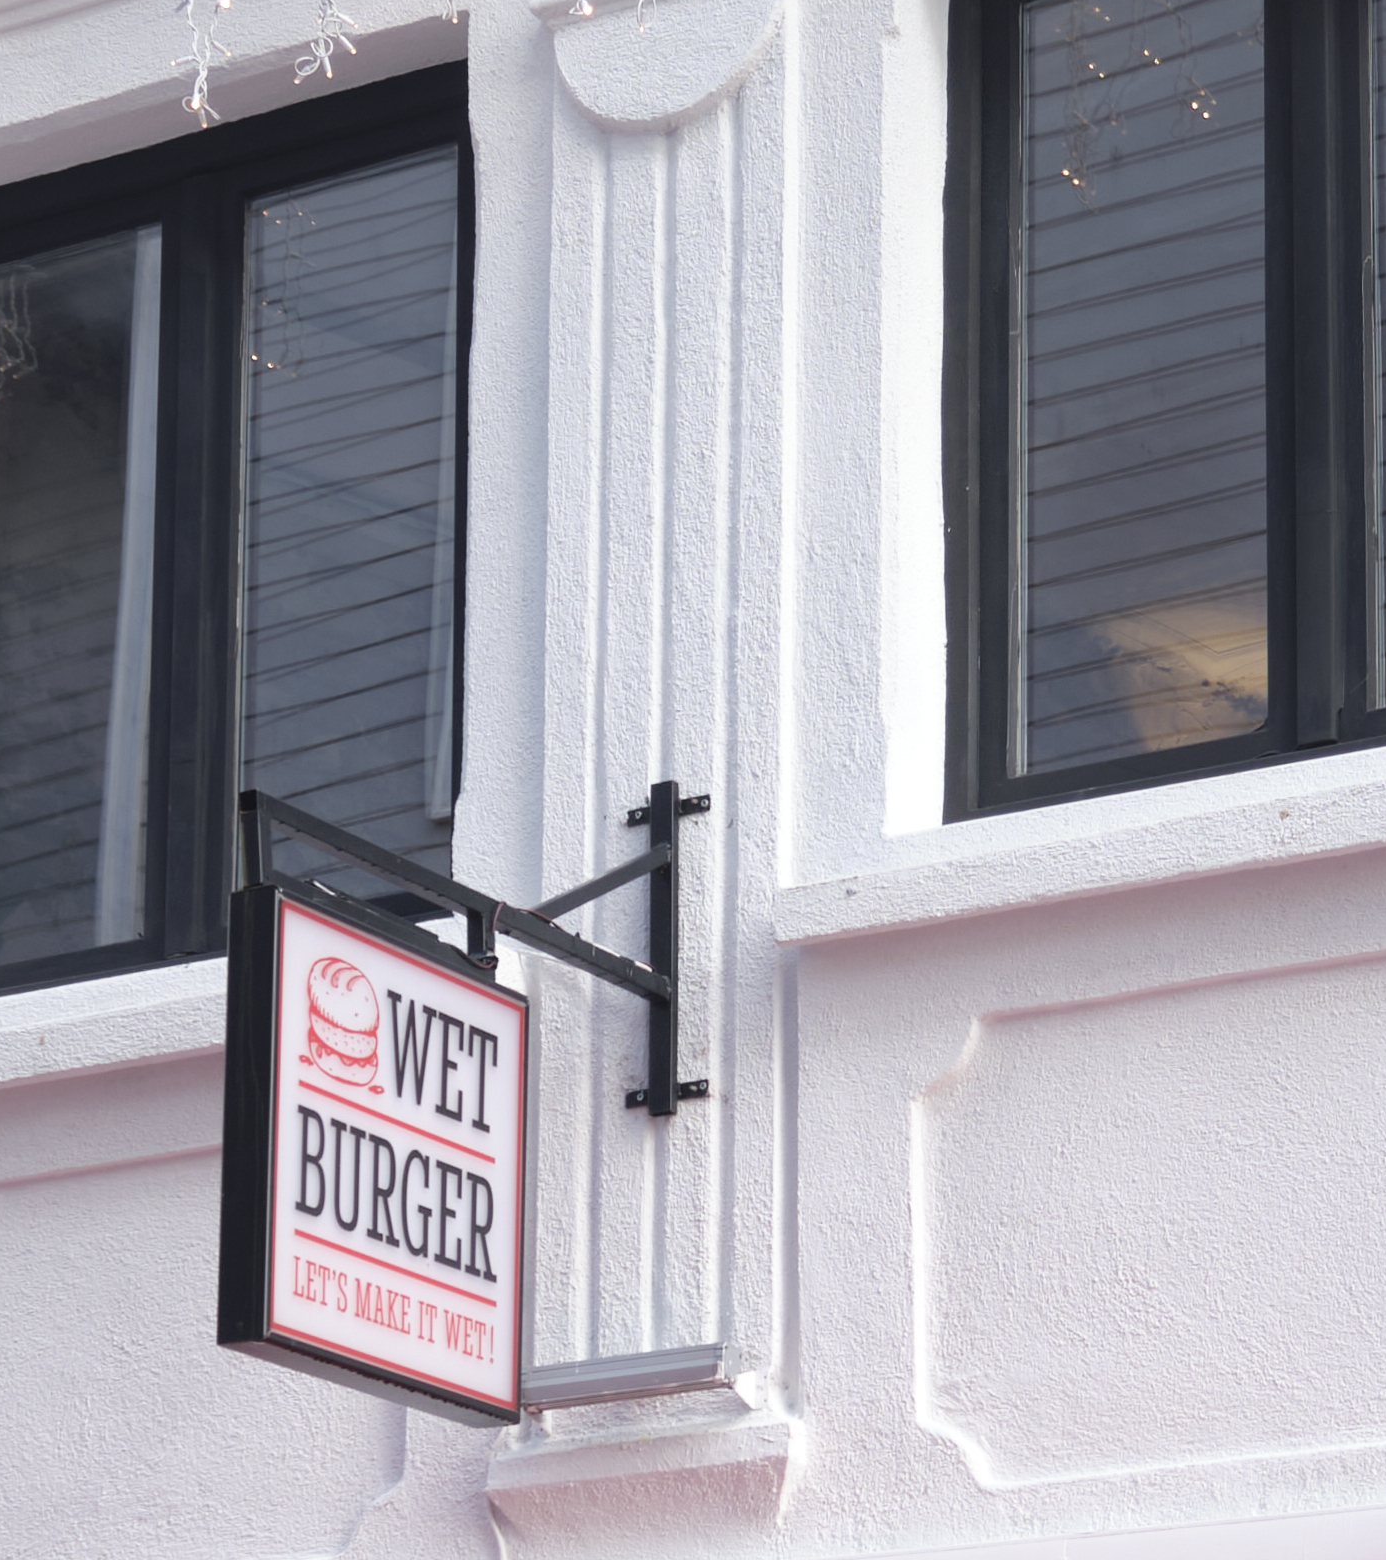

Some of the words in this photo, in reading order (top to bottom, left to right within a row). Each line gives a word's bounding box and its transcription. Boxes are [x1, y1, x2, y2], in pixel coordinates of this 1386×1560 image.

[387, 989, 498, 1133] WET
[295, 1105, 497, 1283] BURGER
[293, 1256, 347, 1312] LET'S
[355, 1278, 411, 1335] MAKE
[418, 1301, 437, 1343] IT
[443, 1309, 494, 1364] WET!
